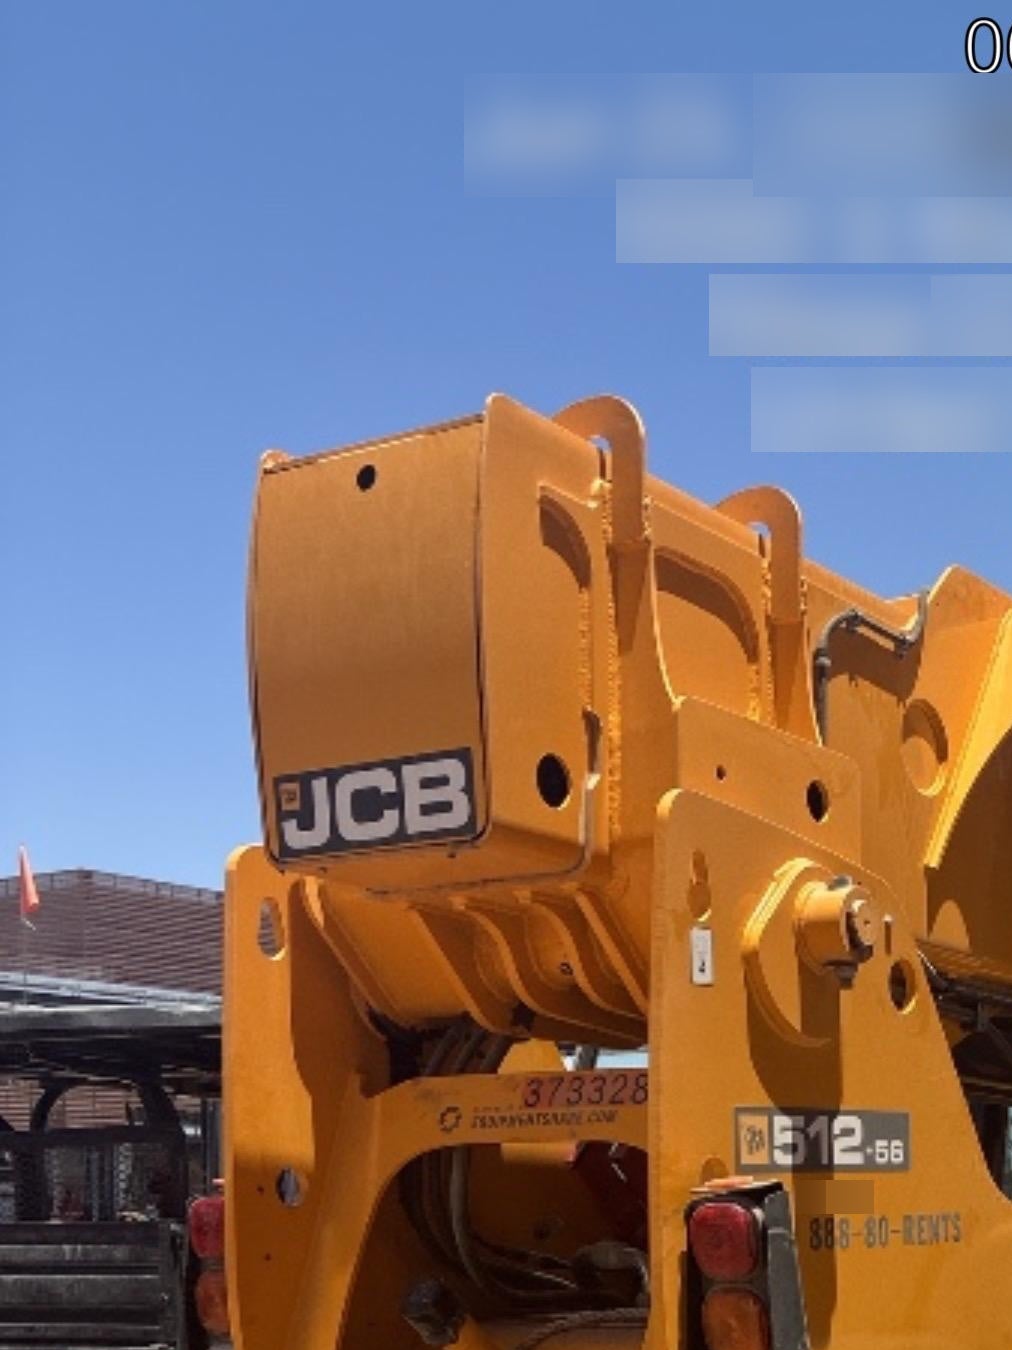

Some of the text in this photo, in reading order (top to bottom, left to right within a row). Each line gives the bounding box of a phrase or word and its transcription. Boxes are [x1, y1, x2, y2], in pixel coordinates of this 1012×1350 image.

[281, 758, 471, 850] JCB
[523, 1073, 648, 1108] 373328
[809, 1213, 961, 1251] 888-80-RENTS
